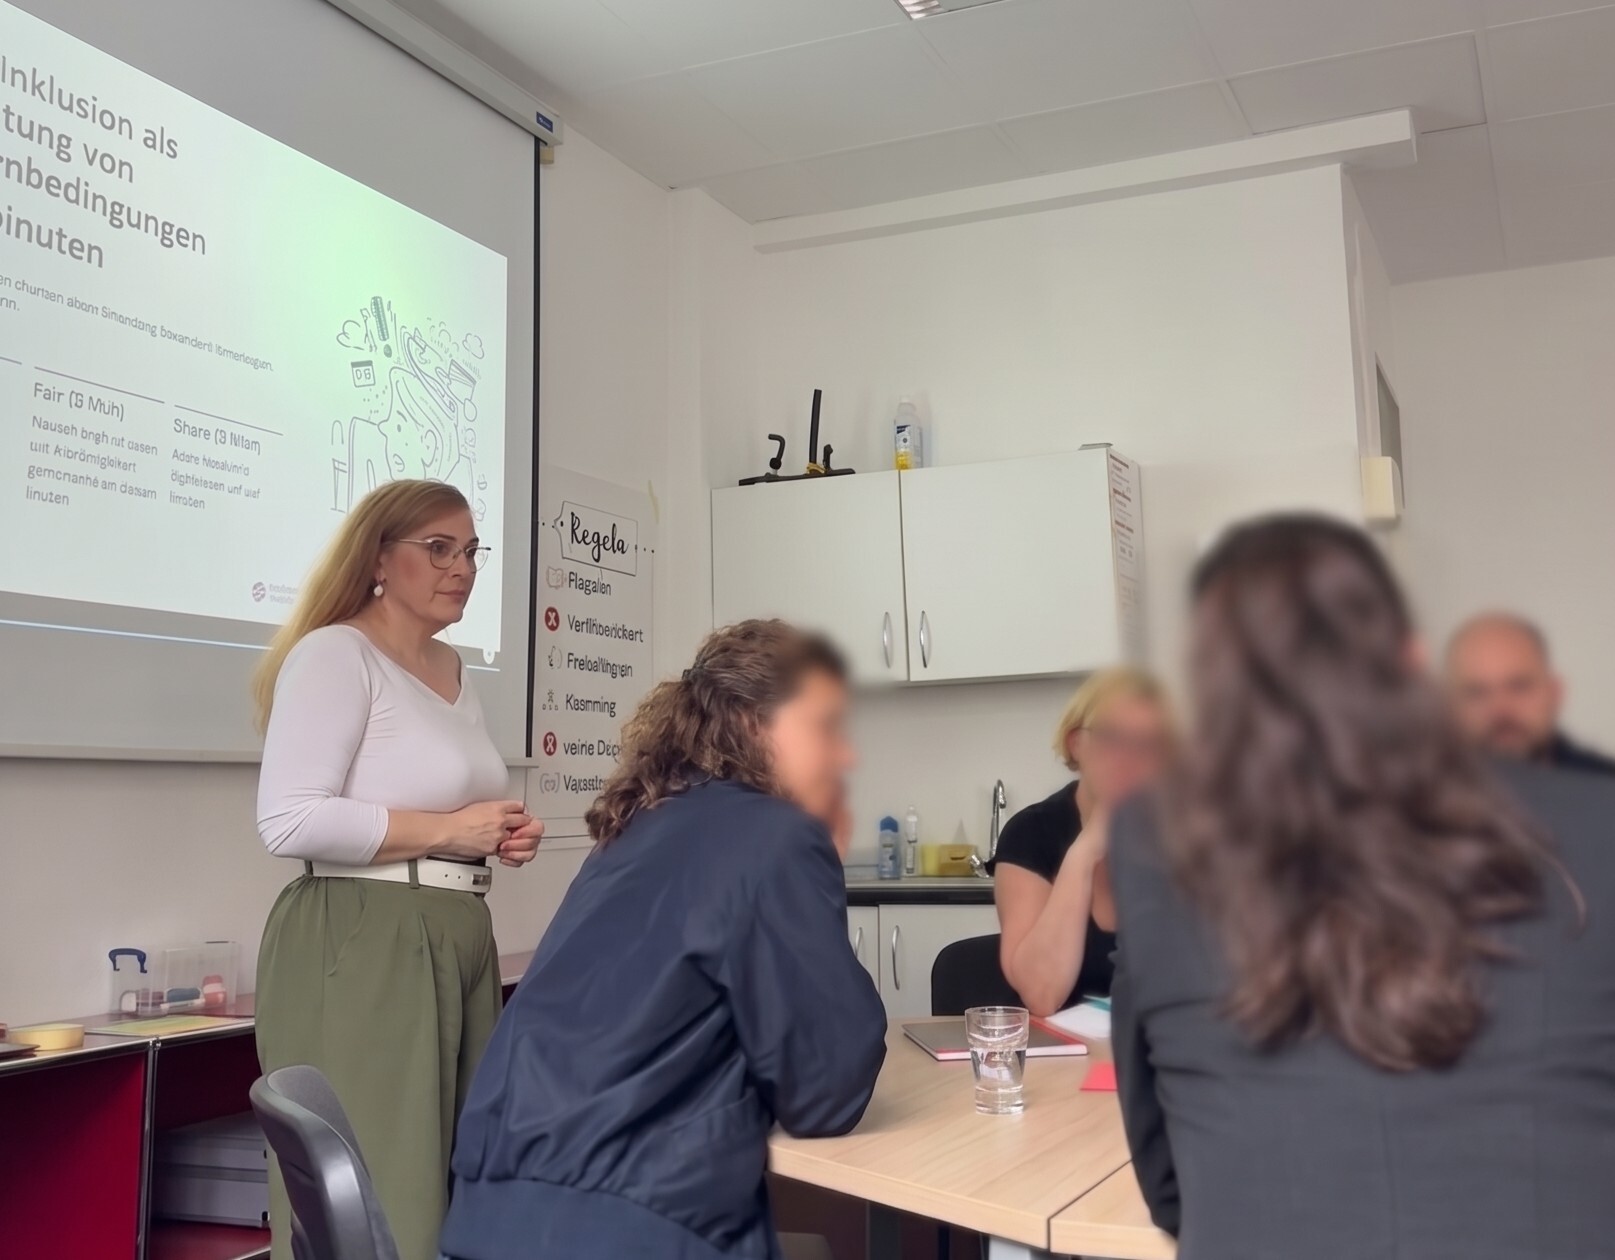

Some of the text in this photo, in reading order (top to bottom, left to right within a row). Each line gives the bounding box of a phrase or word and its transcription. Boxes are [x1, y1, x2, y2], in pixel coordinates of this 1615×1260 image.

[1, 55, 178, 159] Inklusion als
[3, 104, 133, 183] tung von
[34, 382, 64, 403] Fair
[173, 418, 211, 440] Share
